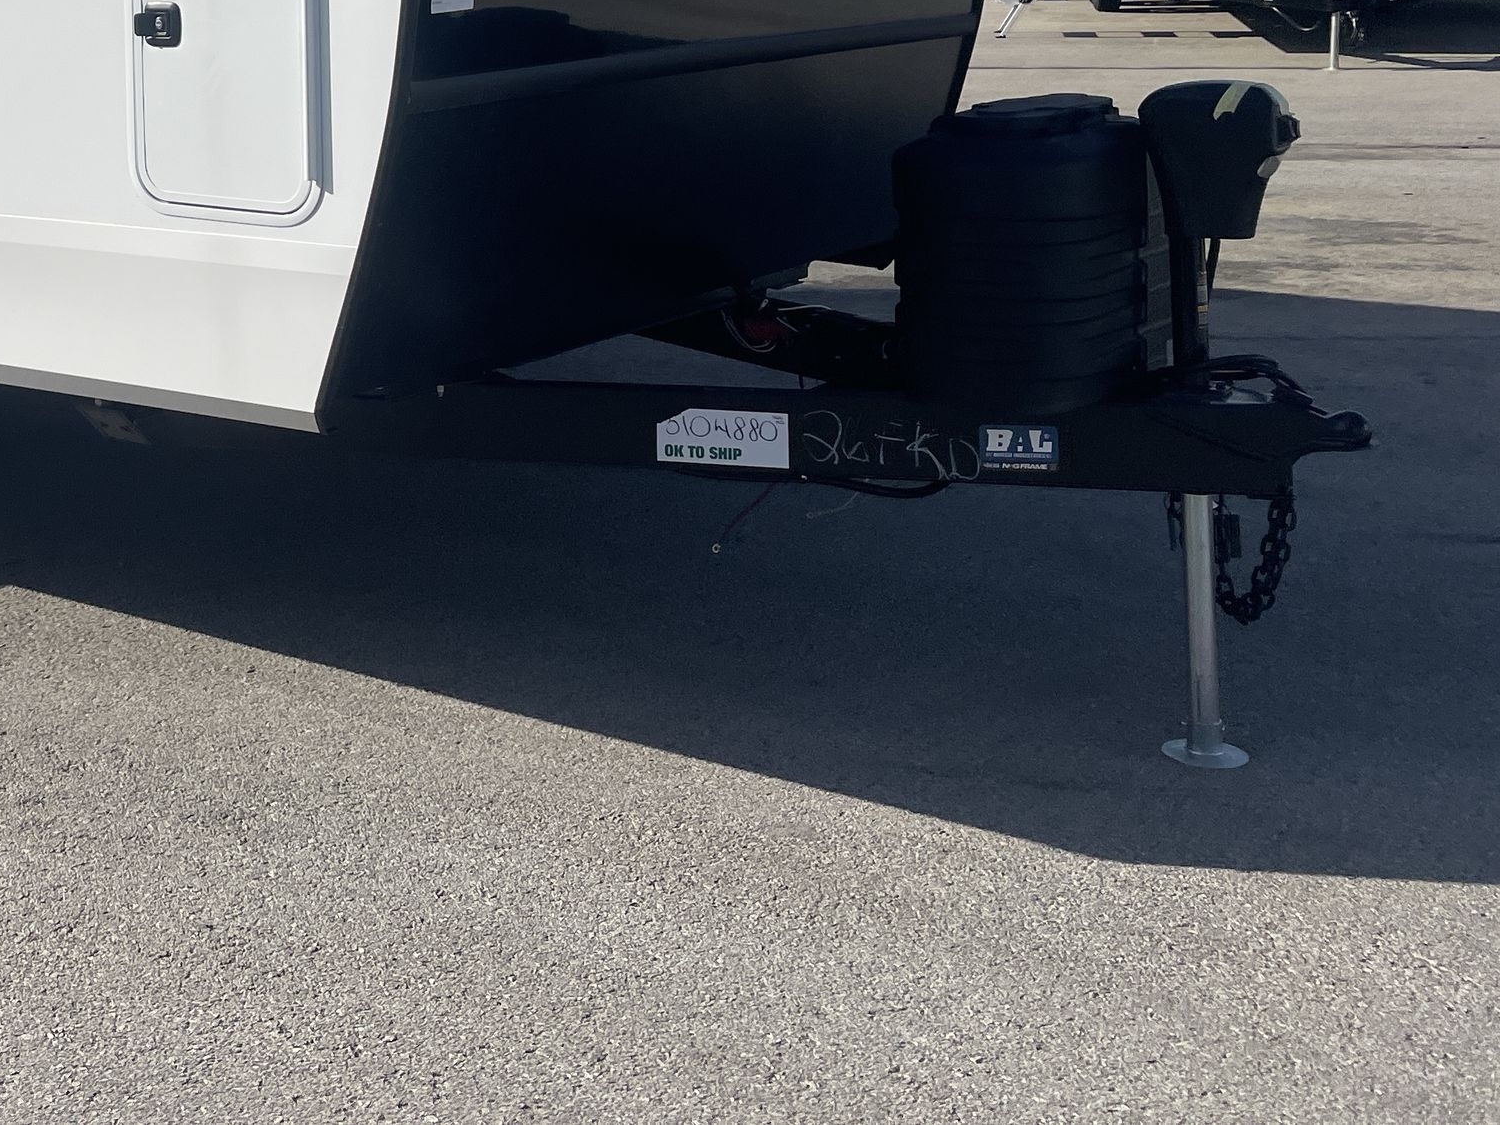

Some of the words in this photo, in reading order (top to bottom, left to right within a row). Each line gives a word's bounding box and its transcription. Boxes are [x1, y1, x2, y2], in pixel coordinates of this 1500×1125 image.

[986, 429, 1052, 452] BAL
[664, 444, 684, 458] OK
[687, 445, 705, 458] TO
[709, 446, 742, 460] SHIP
